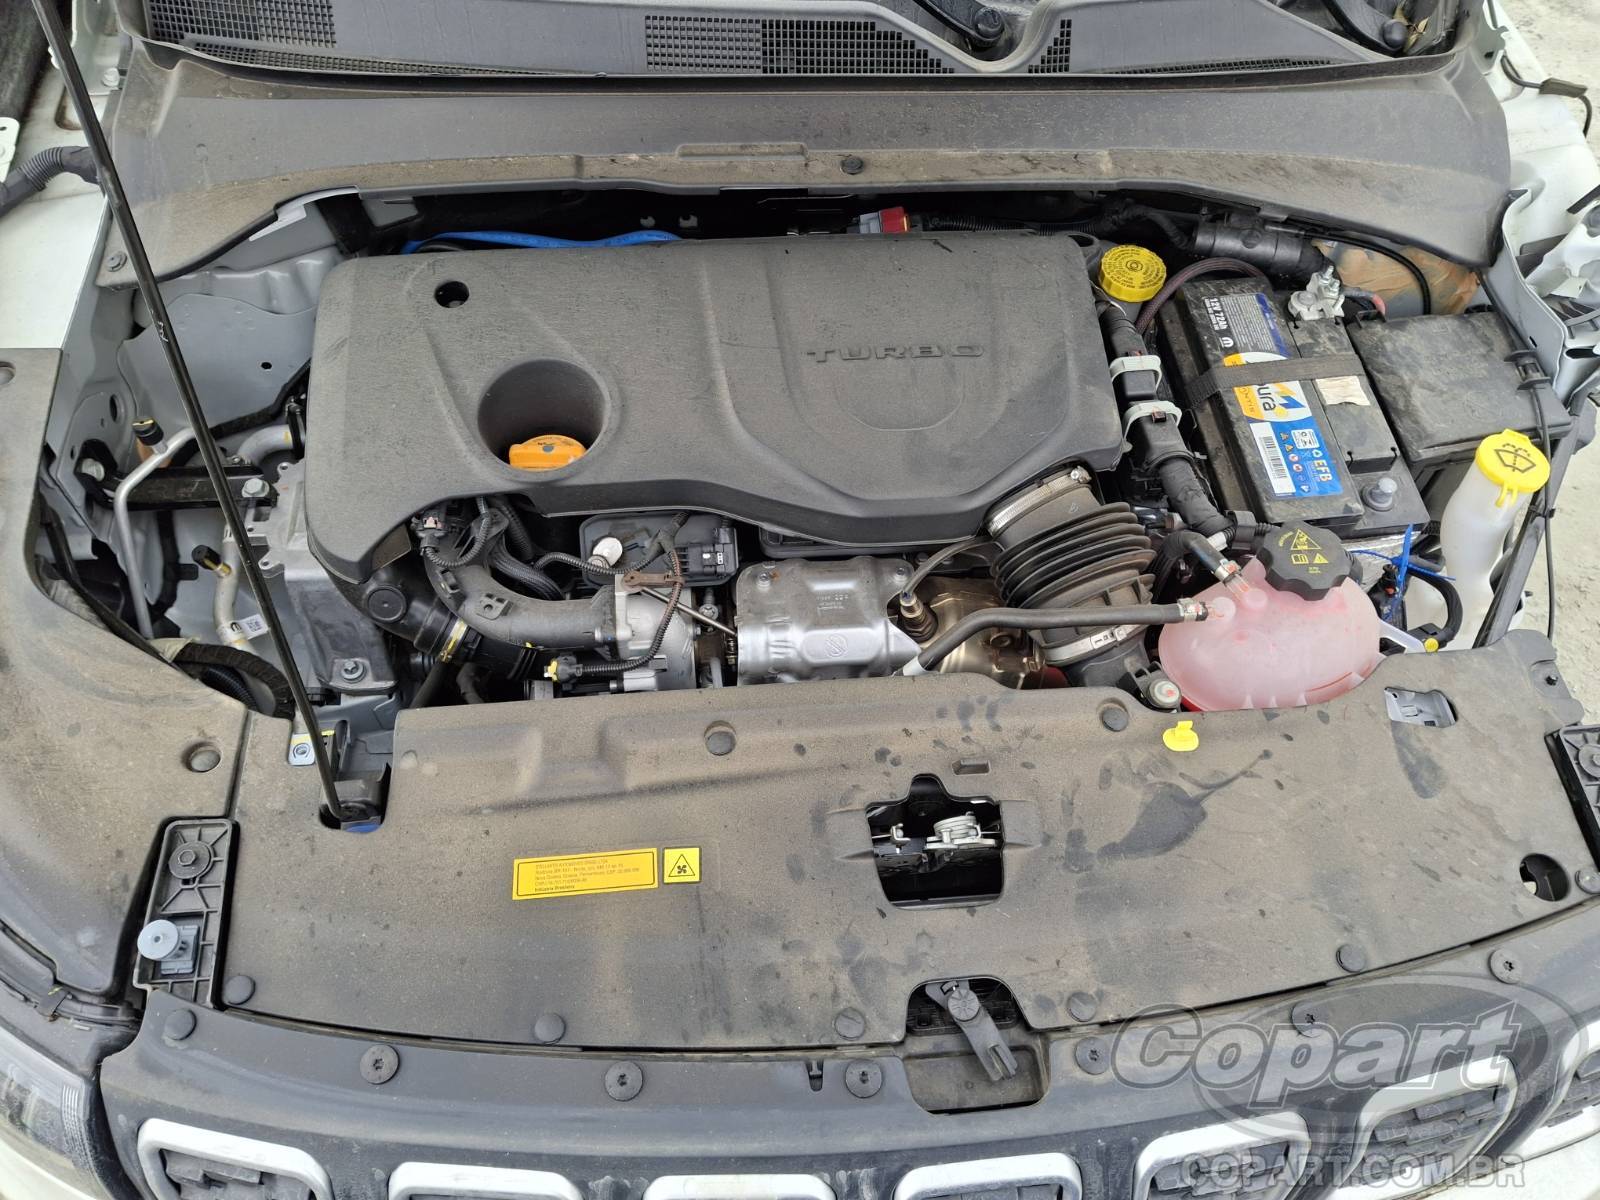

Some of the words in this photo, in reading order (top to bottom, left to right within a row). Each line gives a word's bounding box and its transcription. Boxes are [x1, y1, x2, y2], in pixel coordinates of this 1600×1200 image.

[1209, 298, 1222, 311] 12V
[806, 345, 985, 363] TURBO
[1256, 383, 1277, 411] ura
[1313, 459, 1333, 481] EFB
